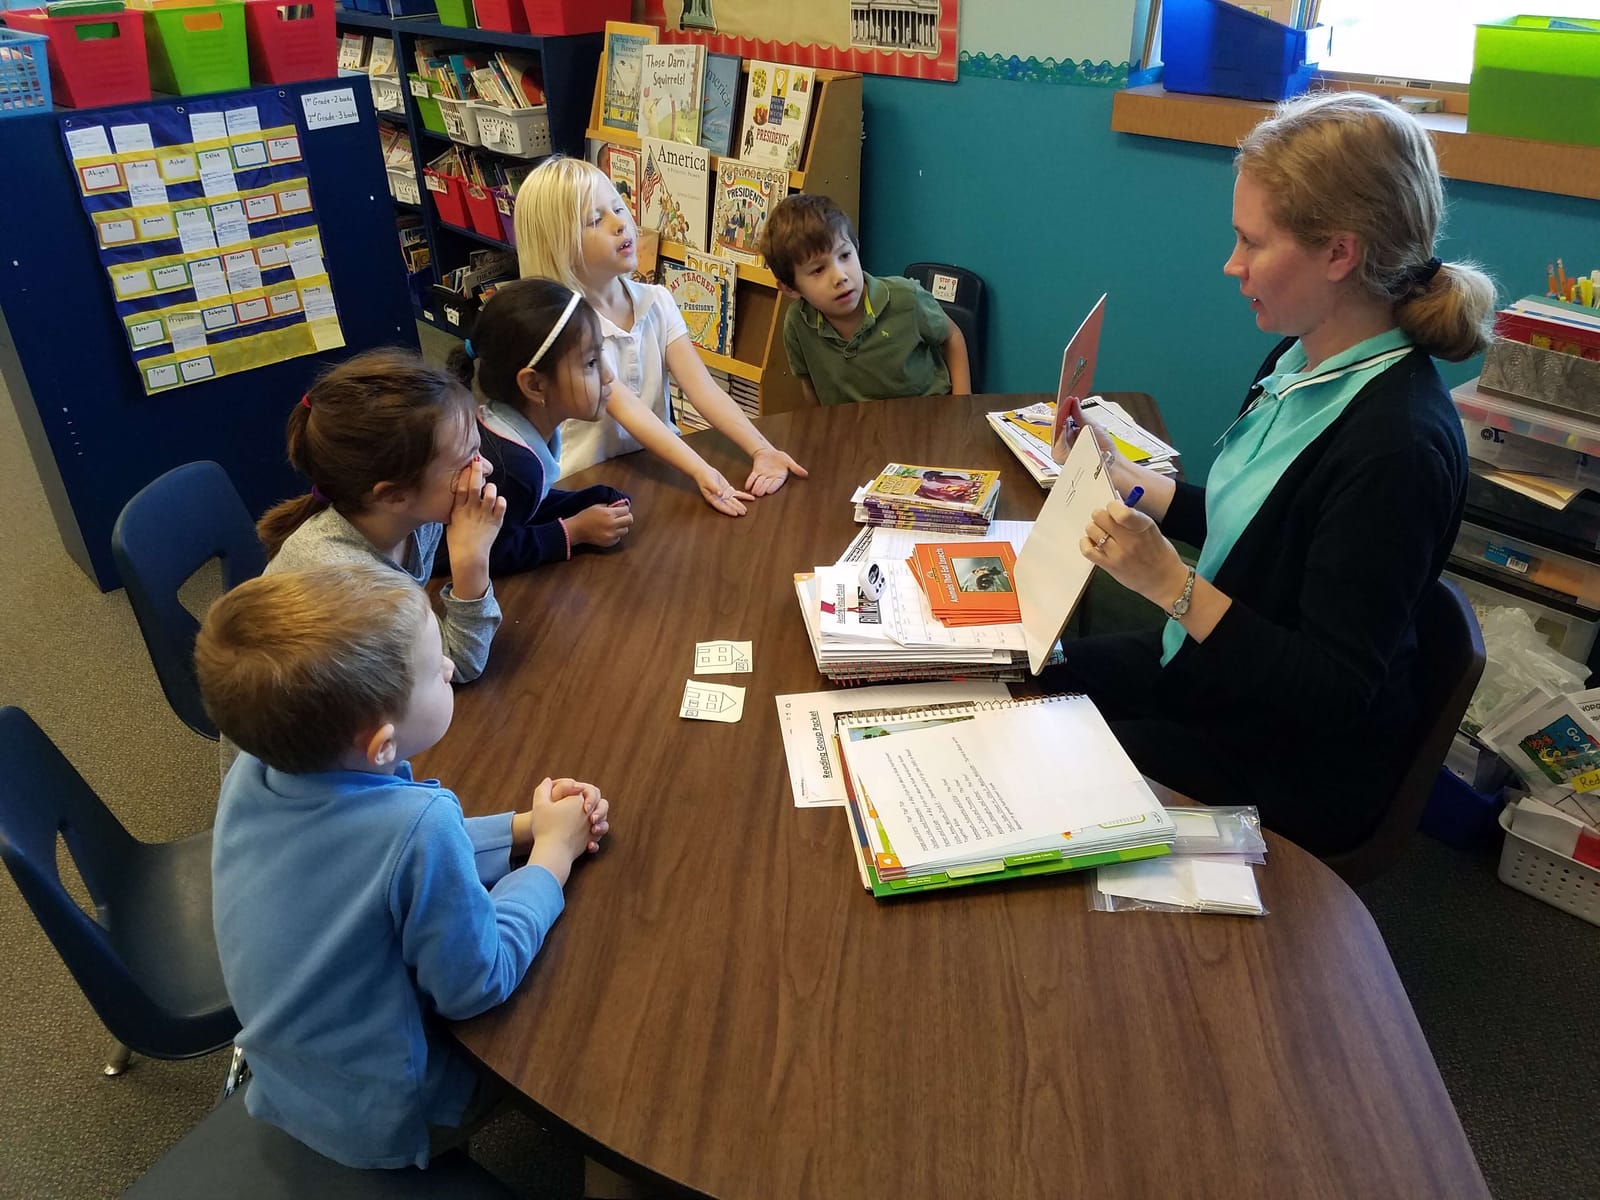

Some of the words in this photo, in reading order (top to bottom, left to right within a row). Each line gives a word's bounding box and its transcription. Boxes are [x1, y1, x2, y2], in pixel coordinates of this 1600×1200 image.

[646, 54, 665, 69] Those
[668, 53, 685, 68] Darn
[653, 71, 686, 88] Squirrels!
[706, 70, 730, 108] merica
[756, 128, 790, 146] PRESIDENTS
[658, 144, 706, 172] America
[726, 186, 766, 208] PRESIDENTS
[670, 277, 681, 293] MY
[682, 272, 716, 296] TEACHER
[684, 302, 714, 312] PRESIDENT
[934, 546, 947, 565] Insects
[939, 563, 949, 574] Eat
[941, 571, 952, 585] That
[944, 582, 959, 604] Animals
[808, 710, 819, 731] Packet
[813, 731, 824, 752] Group
[1566, 727, 1580, 742] Go
[817, 751, 830, 779] Reading
